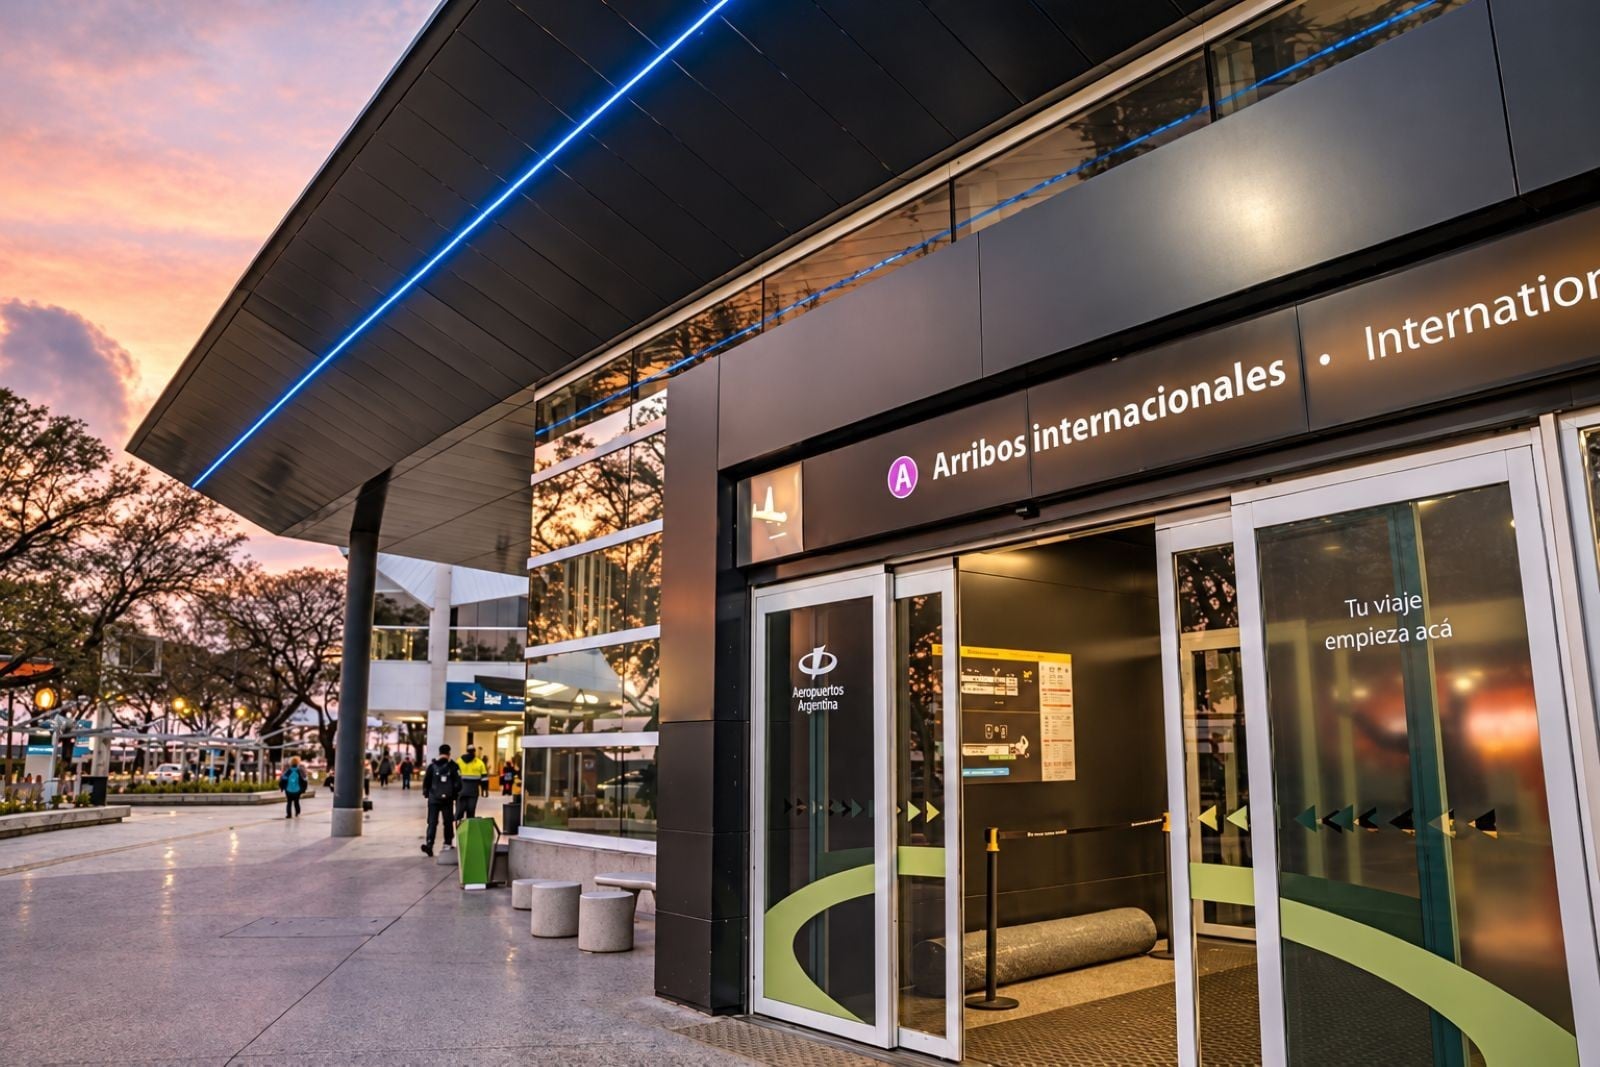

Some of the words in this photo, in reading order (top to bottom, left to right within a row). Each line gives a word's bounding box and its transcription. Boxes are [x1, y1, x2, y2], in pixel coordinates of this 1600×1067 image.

[932, 434, 1027, 480] Arribos
[1033, 358, 1286, 454] internacionales
[1344, 598, 1369, 618] Tu
[1373, 591, 1422, 617] viaje
[1325, 626, 1410, 652] empieza
[1415, 617, 1453, 641] acá
[792, 684, 844, 699] Aeropuertos
[797, 698, 838, 714] Argentina
